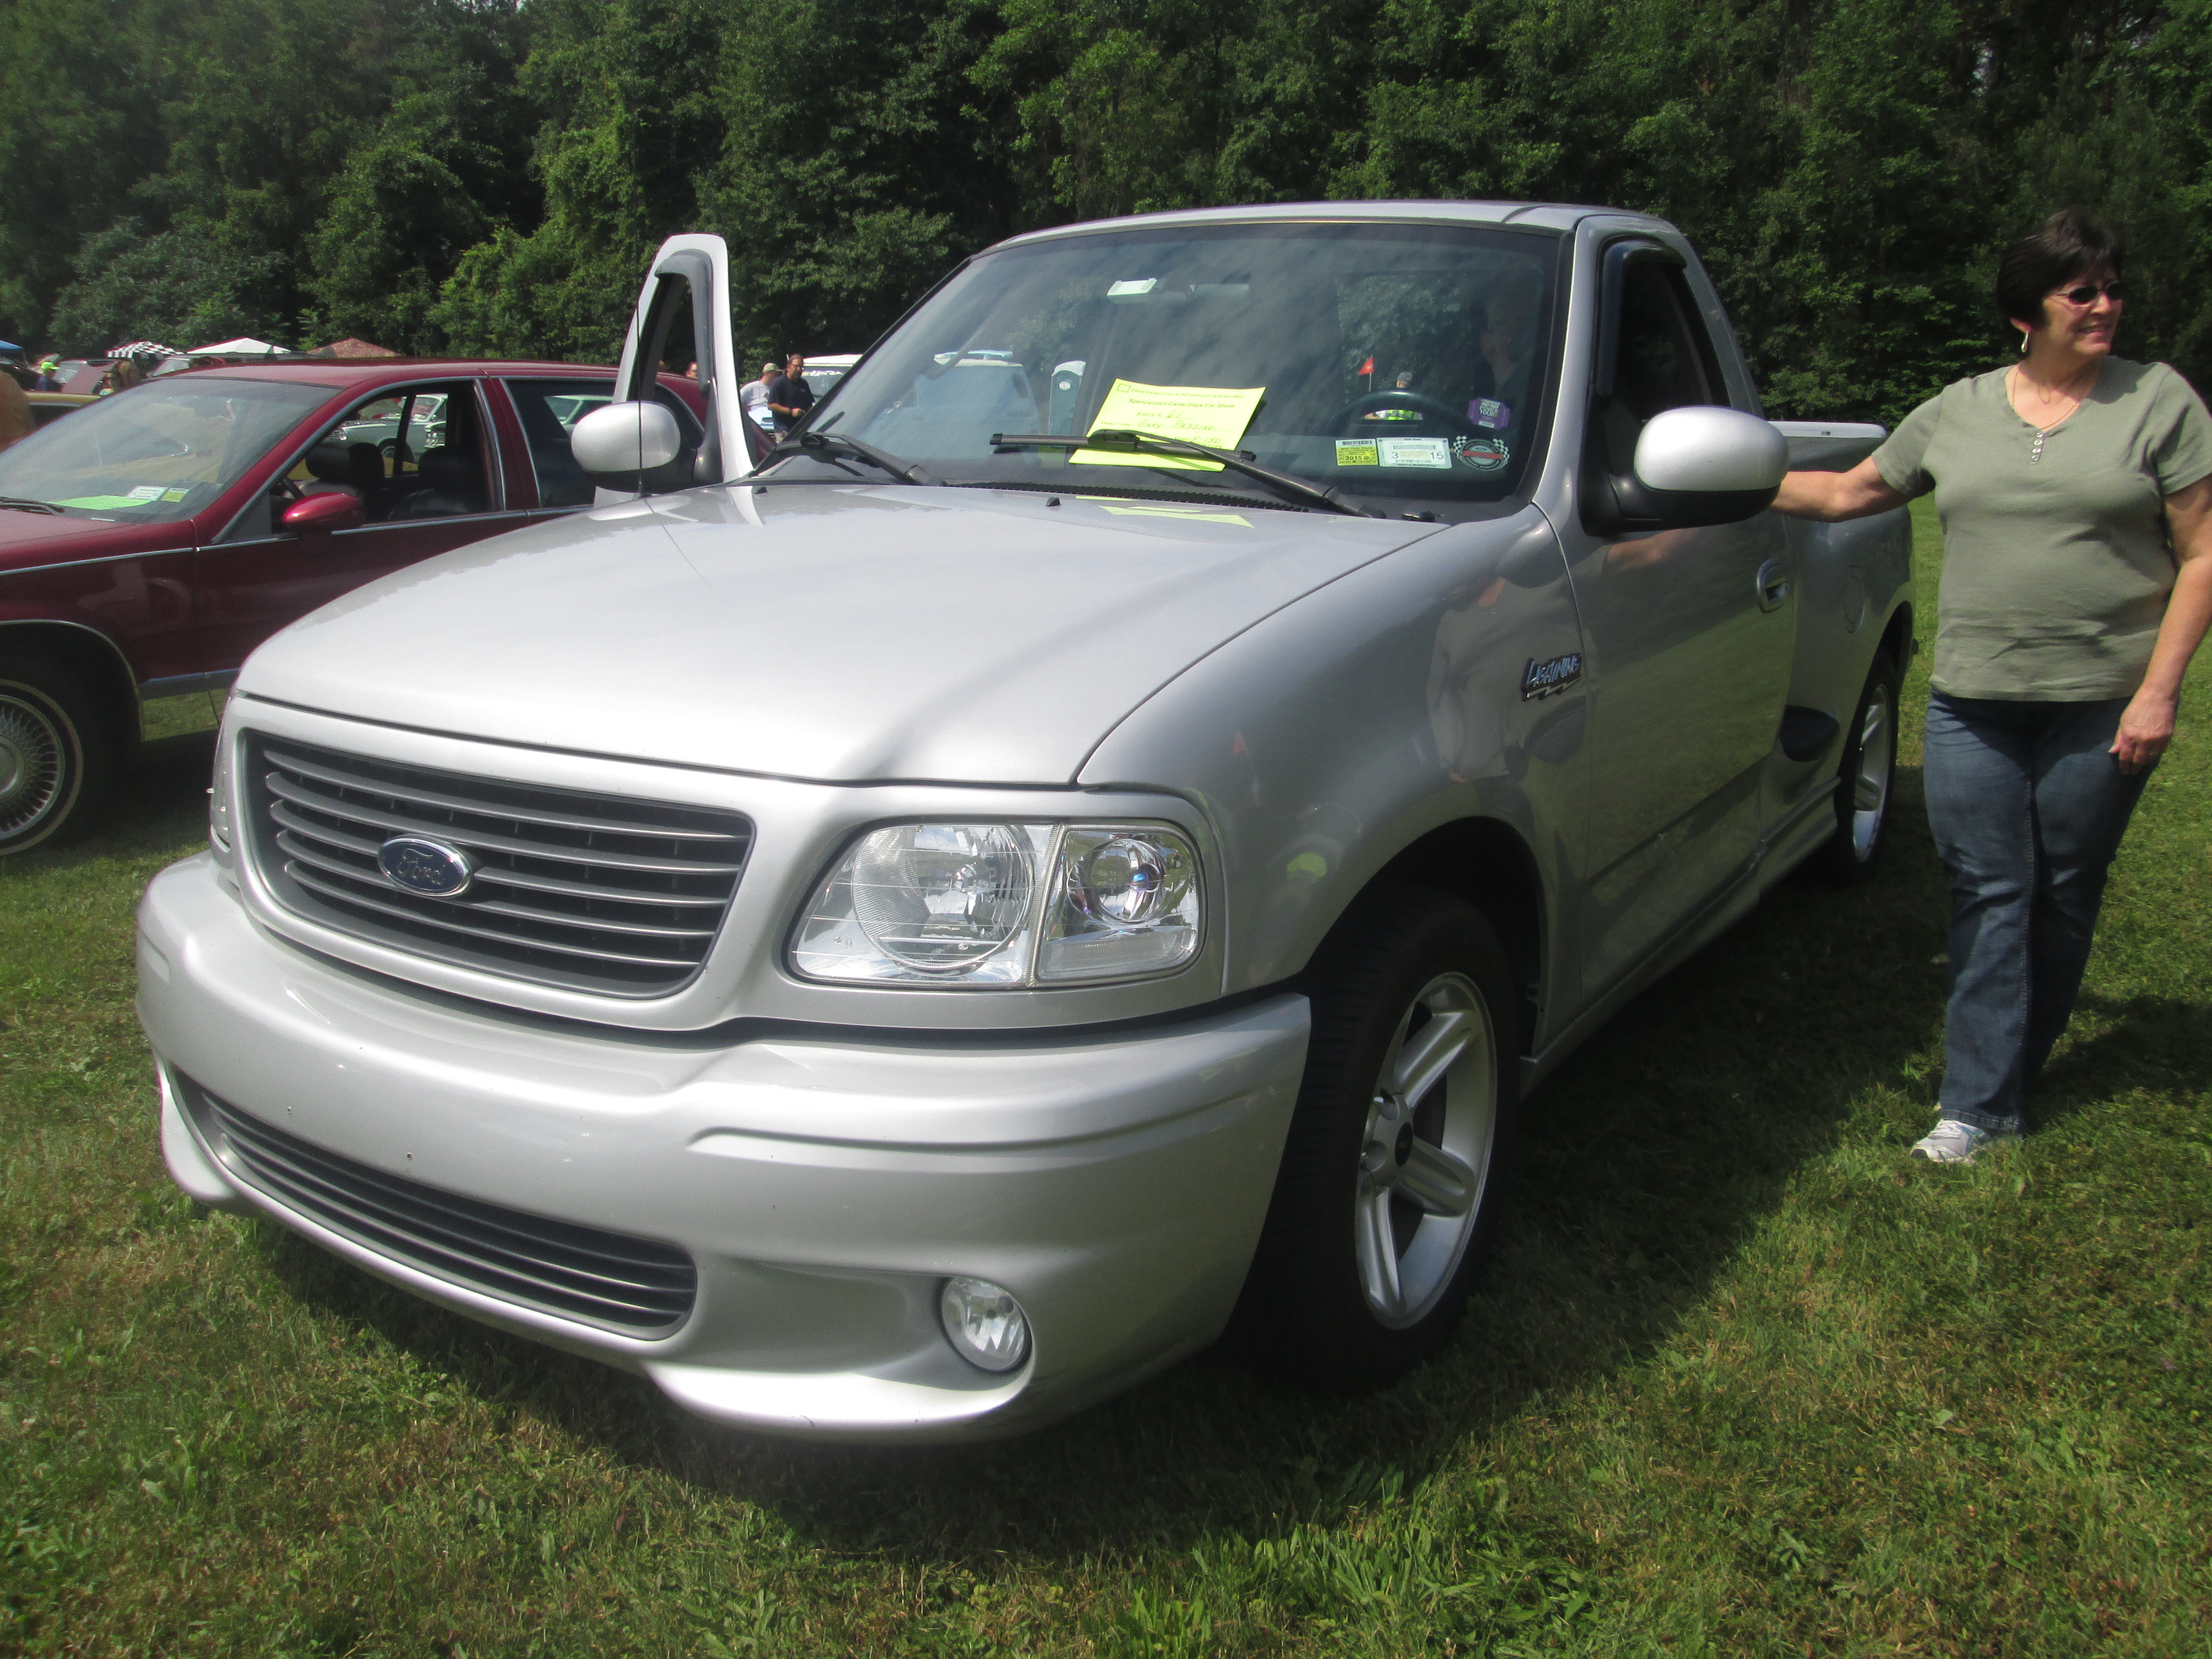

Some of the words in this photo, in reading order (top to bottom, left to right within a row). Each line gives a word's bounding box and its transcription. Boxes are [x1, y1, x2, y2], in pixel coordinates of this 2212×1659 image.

[1167, 410, 1184, 418] 61
[1137, 420, 1163, 430] GARY
[1430, 451, 1444, 459] 15
